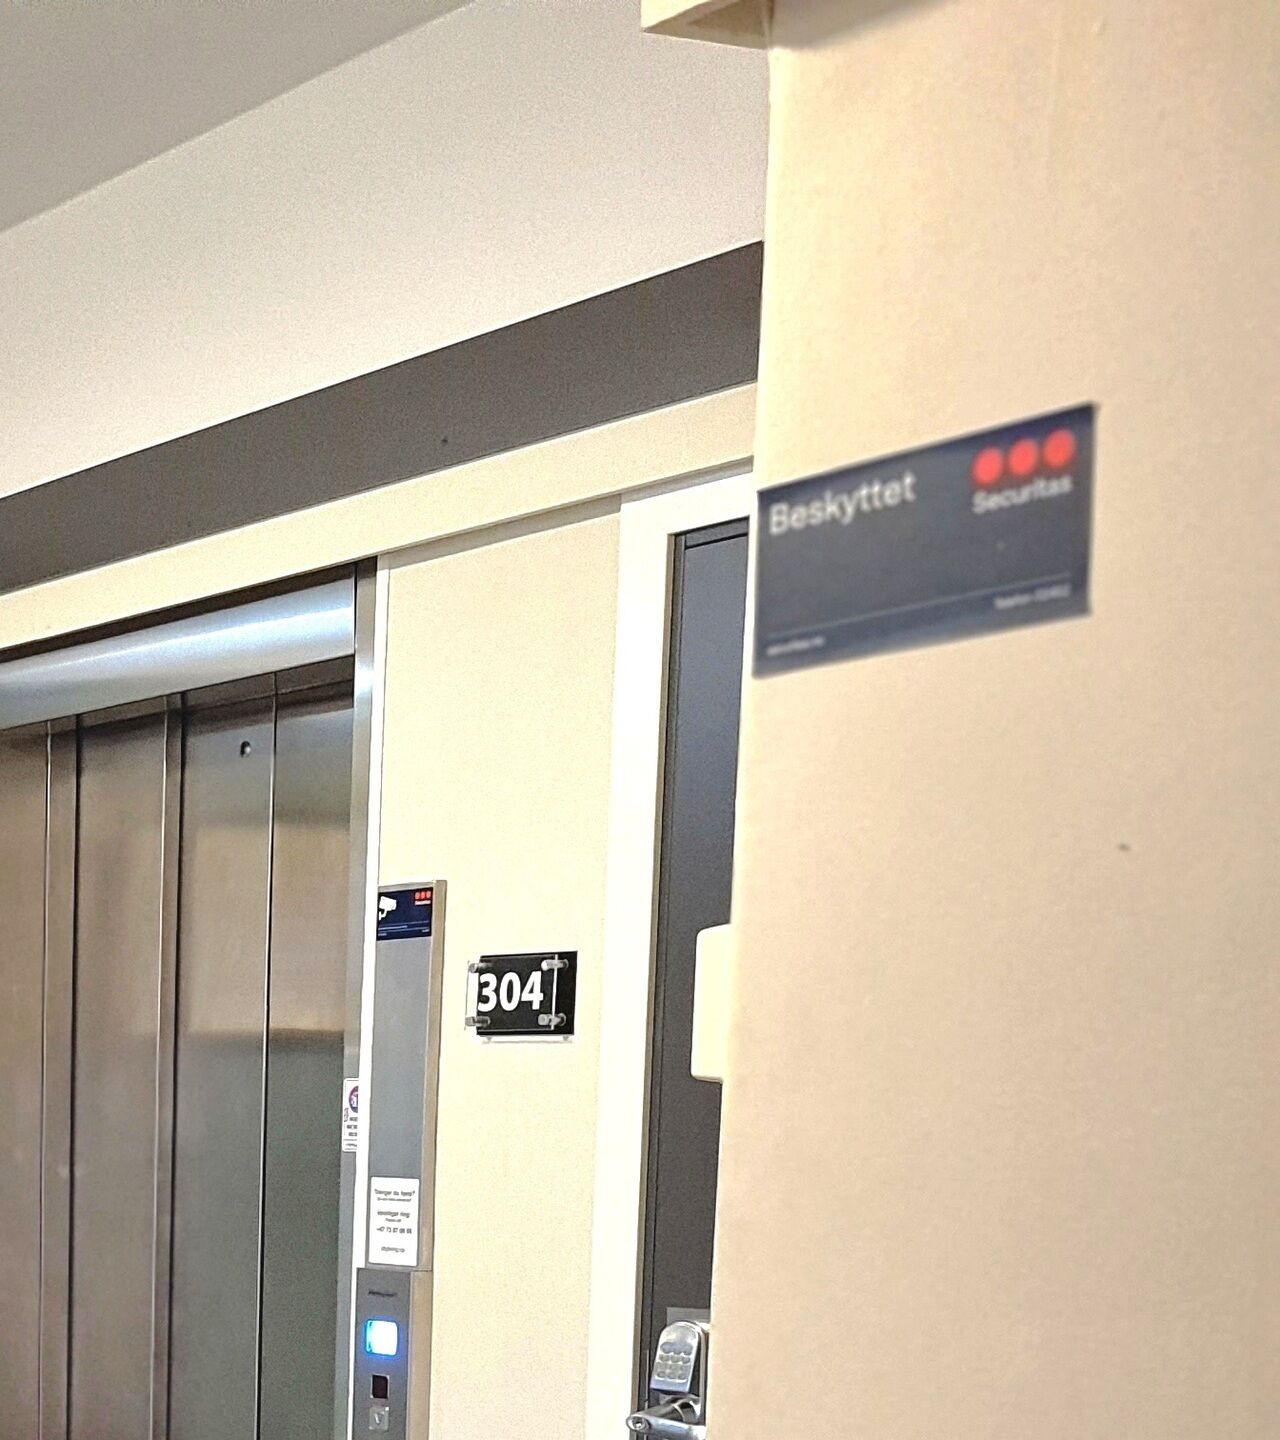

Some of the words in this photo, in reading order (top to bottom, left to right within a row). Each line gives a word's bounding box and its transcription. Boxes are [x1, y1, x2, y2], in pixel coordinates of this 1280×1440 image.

[768, 472, 917, 535] Beskyttet
[971, 474, 1074, 515] Securitas
[477, 971, 544, 1012] 304
